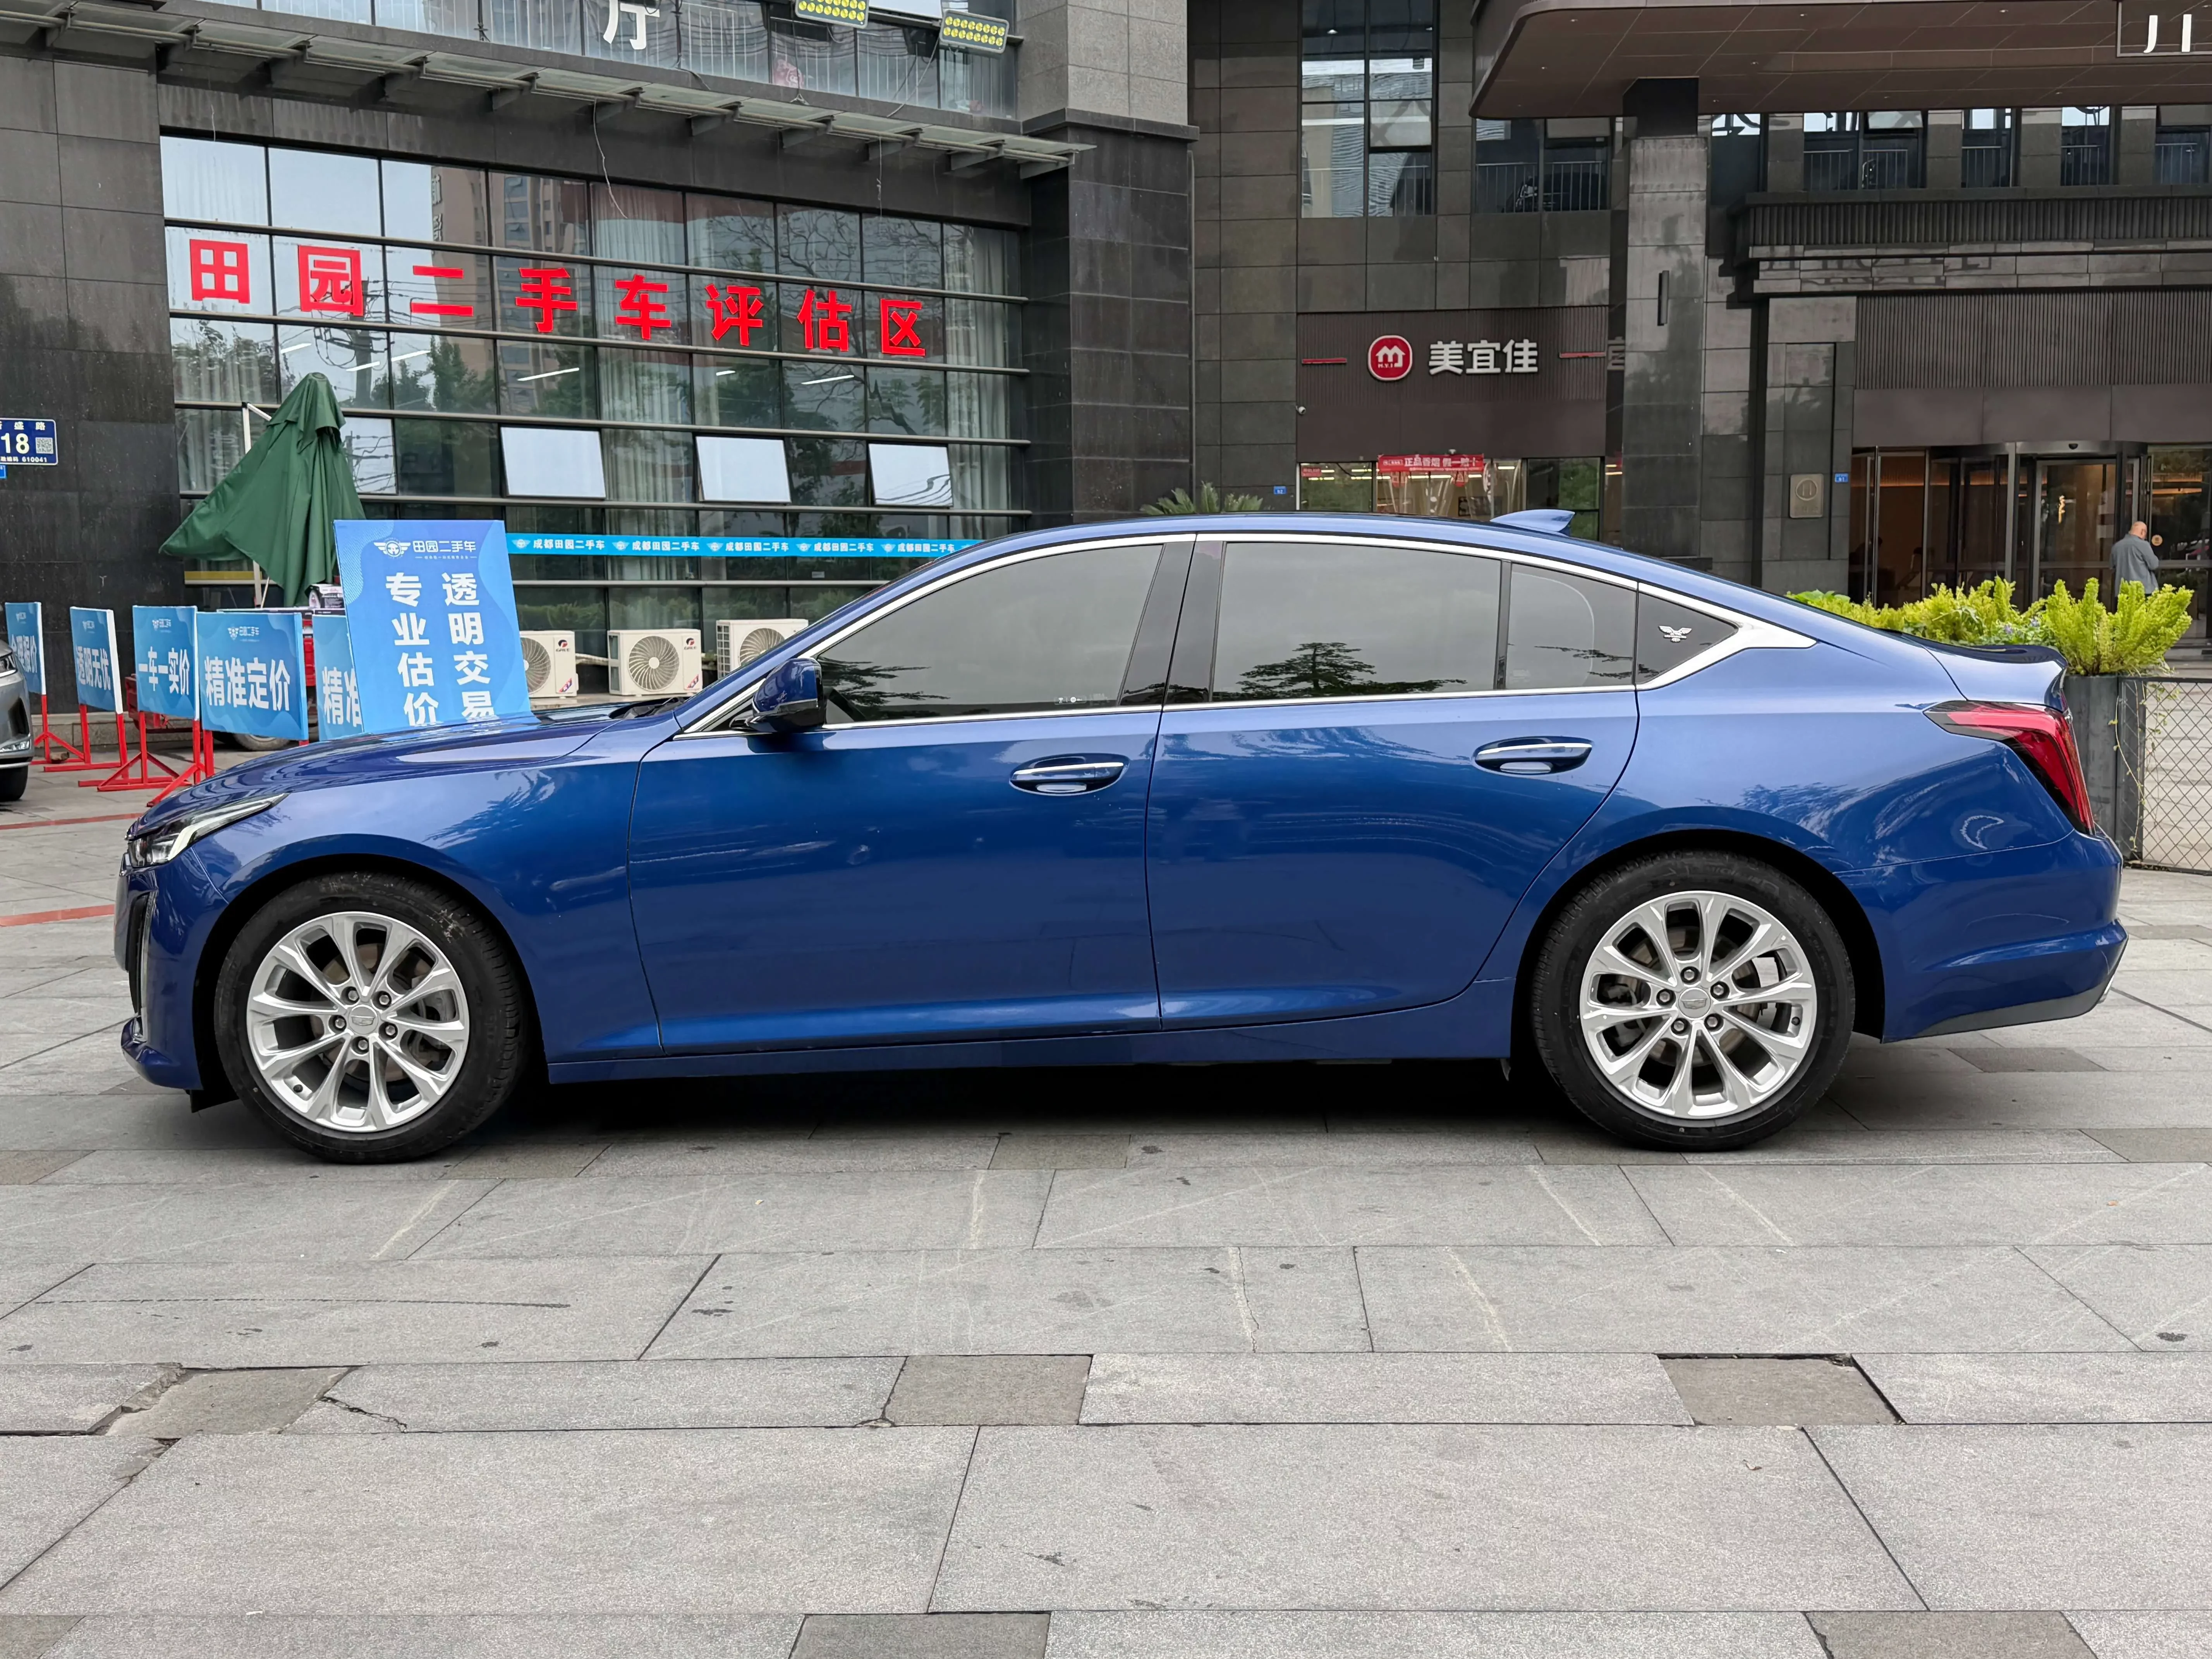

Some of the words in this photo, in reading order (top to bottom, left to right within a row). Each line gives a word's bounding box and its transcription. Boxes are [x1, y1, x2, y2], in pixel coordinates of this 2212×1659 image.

[2143, 14, 2192, 53] JI
[189, 239, 926, 356] 田园二手车评估区
[1429, 339, 1538, 375] 美宜佳
[1, 433, 29, 454] 18
[413, 540, 476, 552] 田园二手车
[533, 539, 605, 550] 成都田园二手车
[632, 541, 700, 551] 成都田园二手车
[725, 542, 789, 551] 成都田园二手车
[814, 543, 874, 552] 成都田园二手车
[386, 572, 439, 726] 专业估价
[441, 572, 495, 718] 透明交易
[76, 646, 111, 690] 透明无忧
[139, 646, 190, 695] 一车一实价
[204, 656, 290, 711] 精准定价
